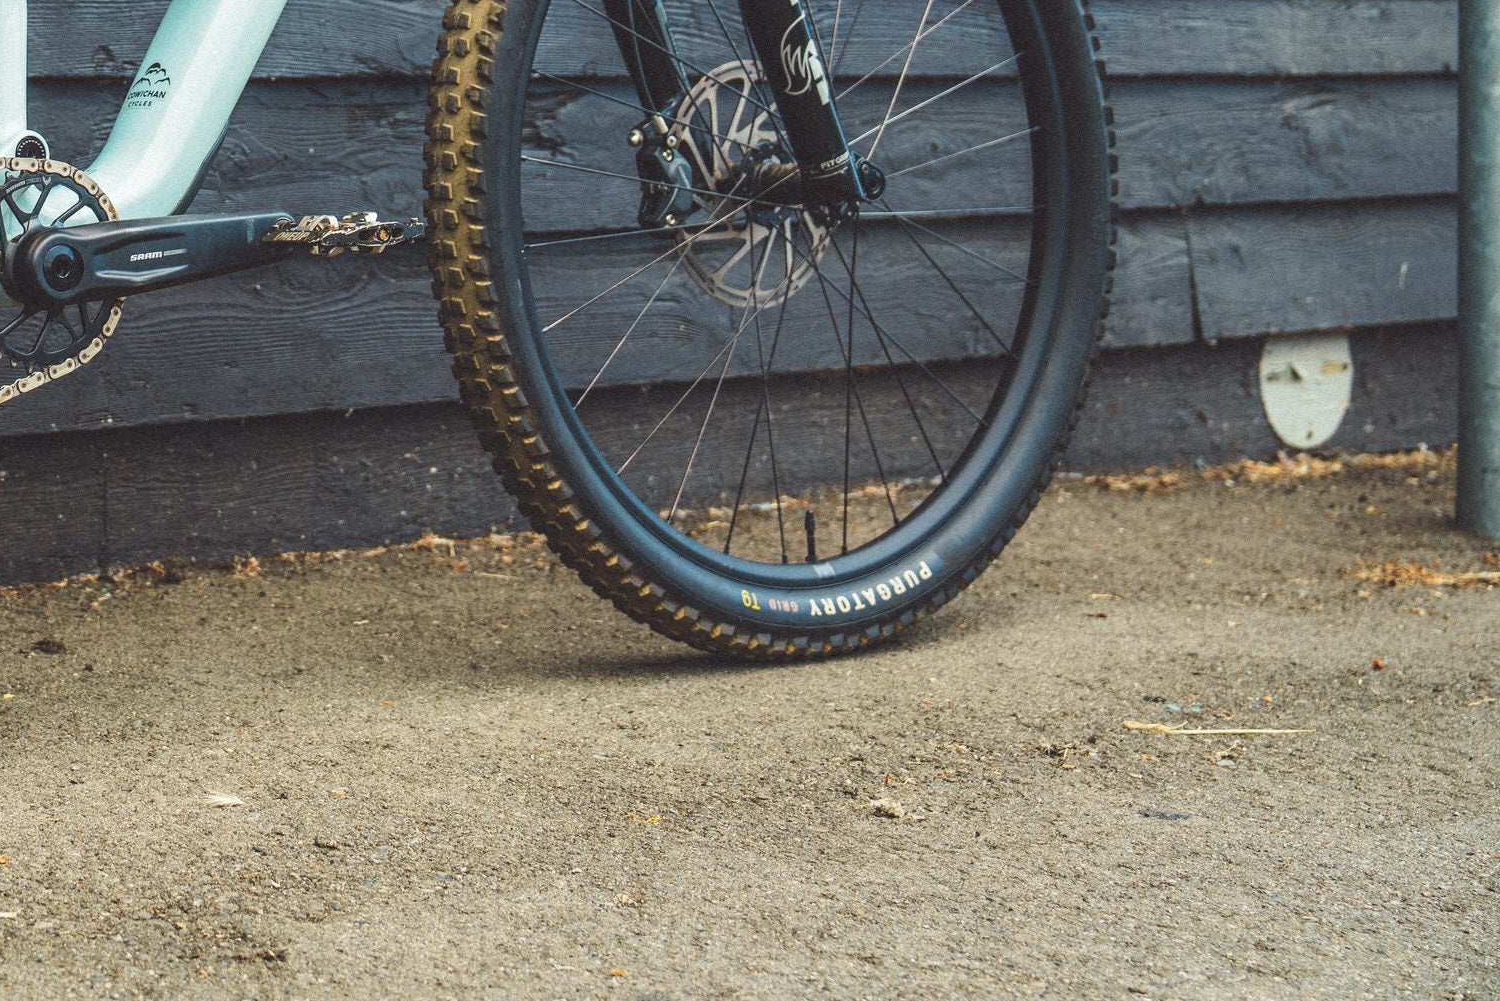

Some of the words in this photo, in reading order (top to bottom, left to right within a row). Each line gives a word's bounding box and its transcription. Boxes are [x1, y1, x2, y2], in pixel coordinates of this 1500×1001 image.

[129, 251, 163, 262] SRAM
[809, 560, 933, 617] PURGATORY
[768, 597, 799, 613] GRID
